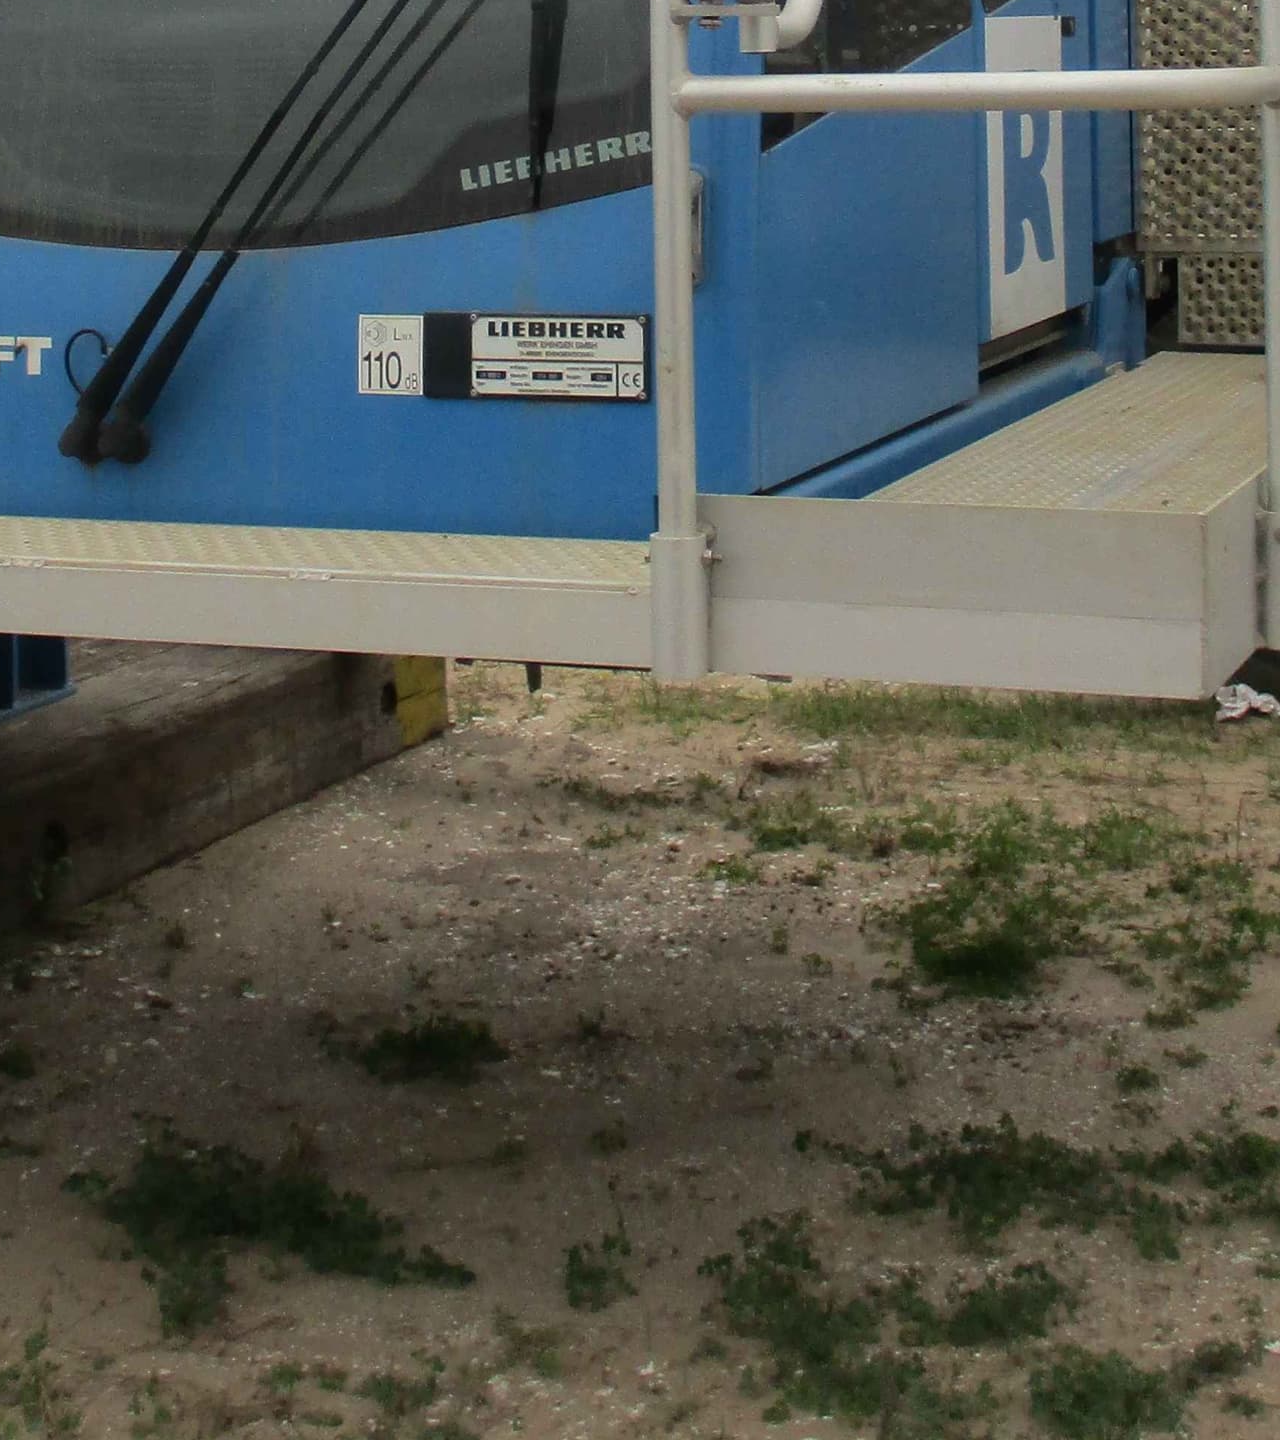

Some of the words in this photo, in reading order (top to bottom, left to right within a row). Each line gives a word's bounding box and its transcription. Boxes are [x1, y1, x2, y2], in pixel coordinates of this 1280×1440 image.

[487, 321, 625, 339] LIEBHERR
[363, 351, 401, 389] 110
[405, 373, 417, 389] dB
